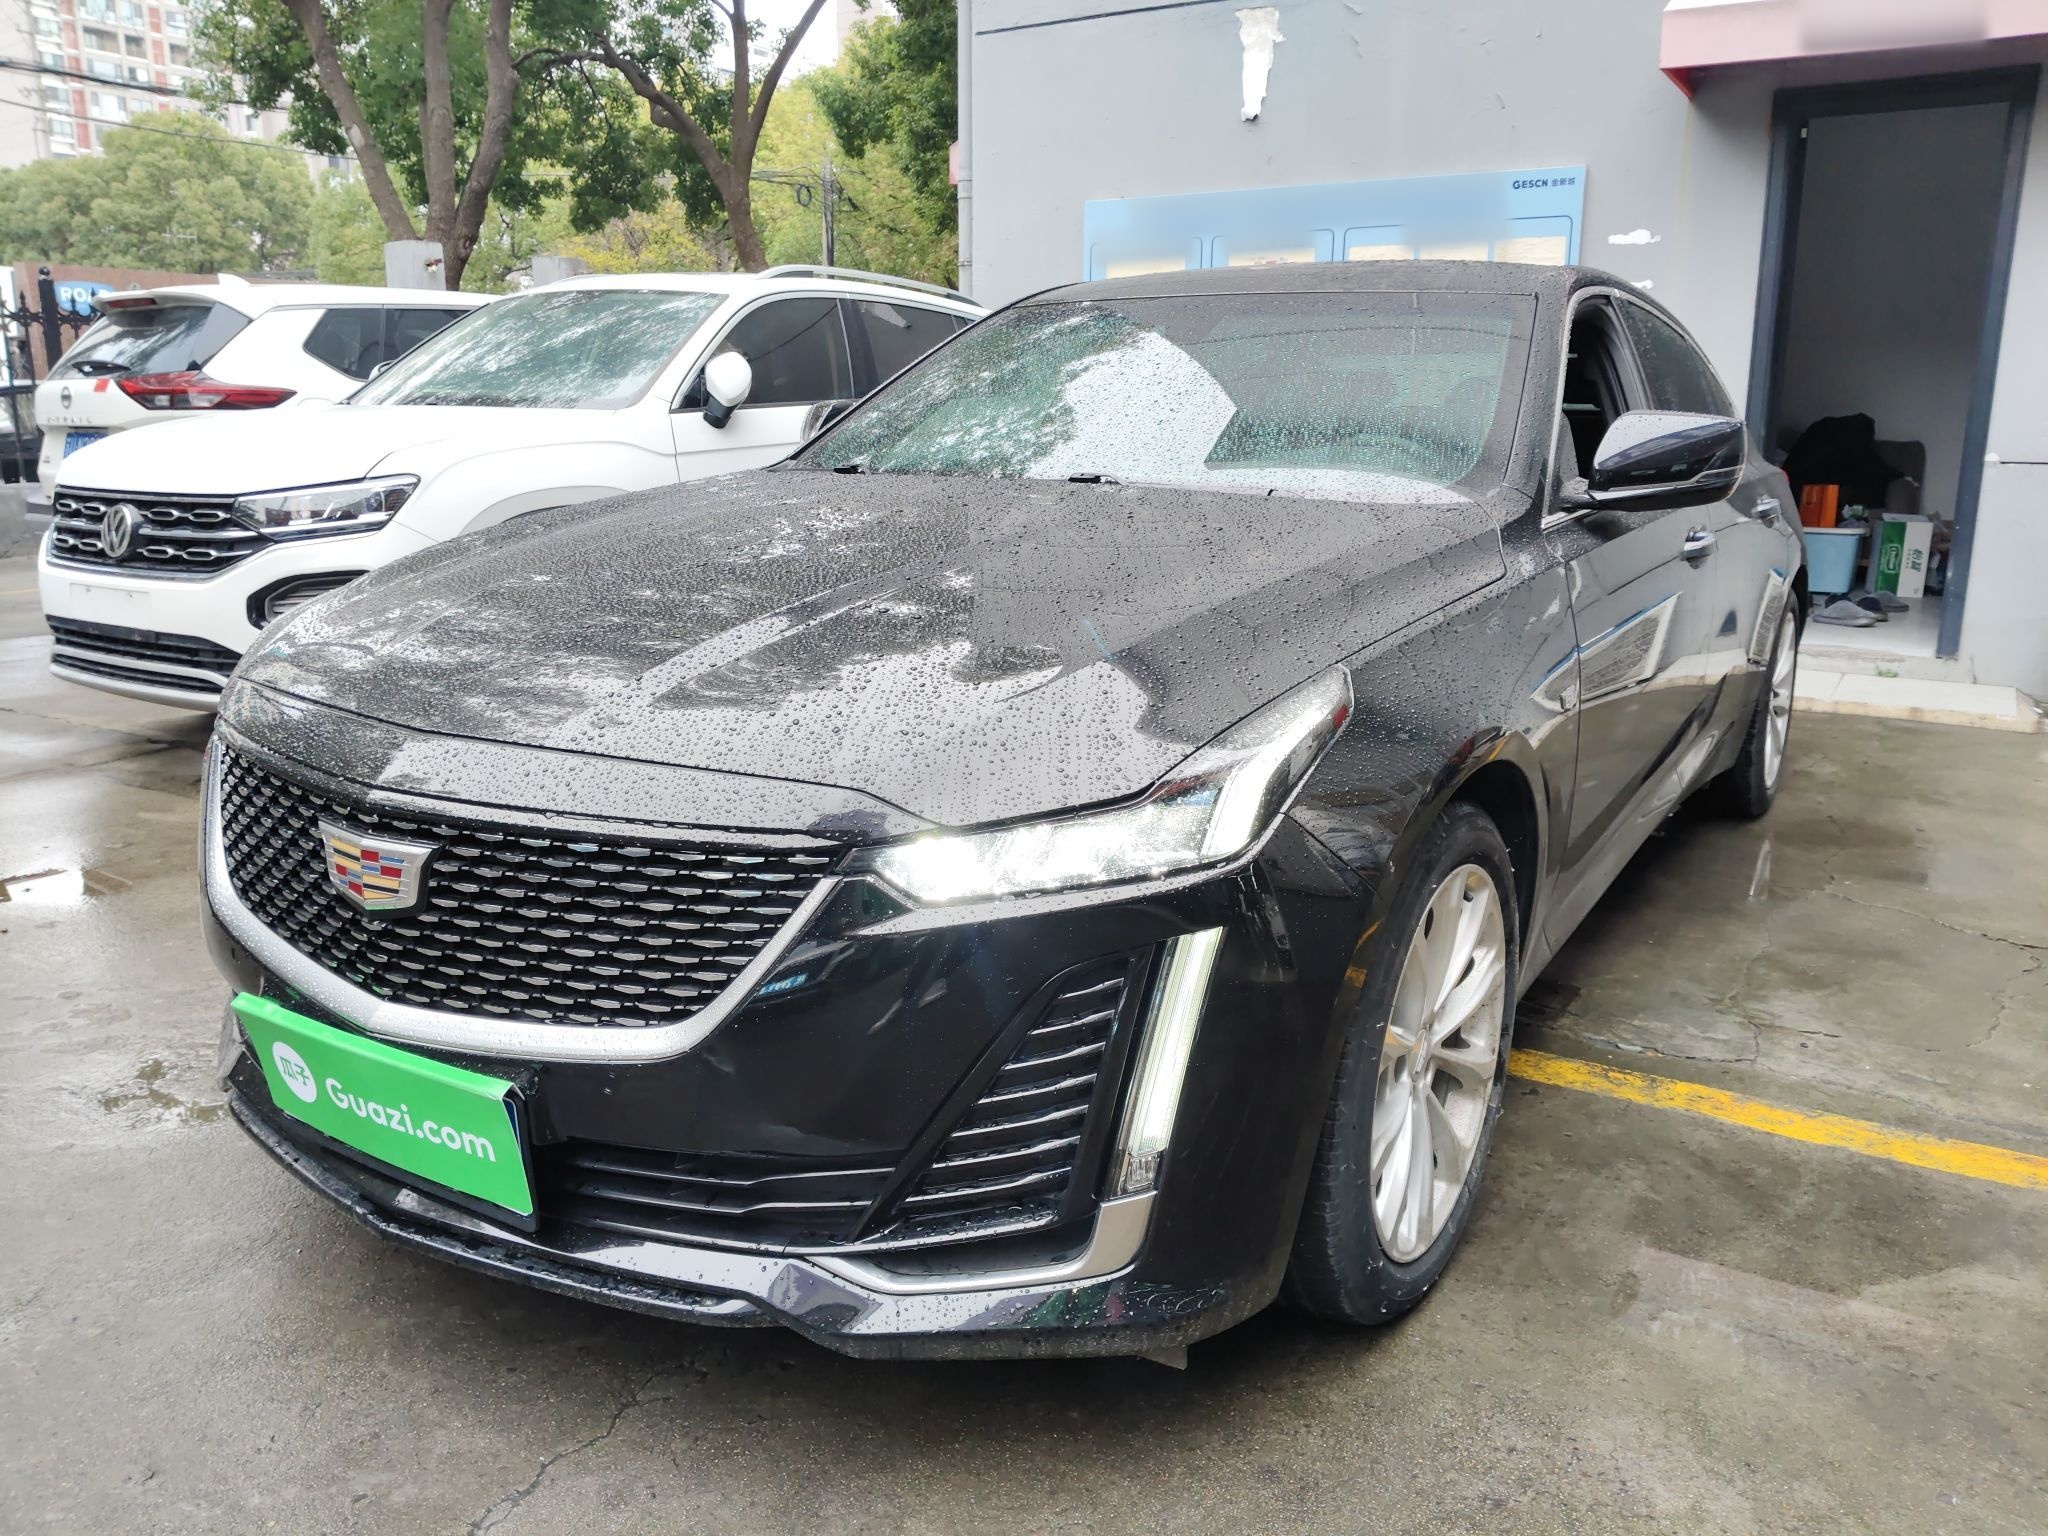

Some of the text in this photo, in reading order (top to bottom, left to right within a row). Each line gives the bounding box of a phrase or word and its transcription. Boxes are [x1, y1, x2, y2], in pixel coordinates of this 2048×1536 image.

[1512, 178, 1548, 189] GESCN
[279, 1056, 310, 1086] 瓜子
[325, 1077, 496, 1162] Guazi.com
